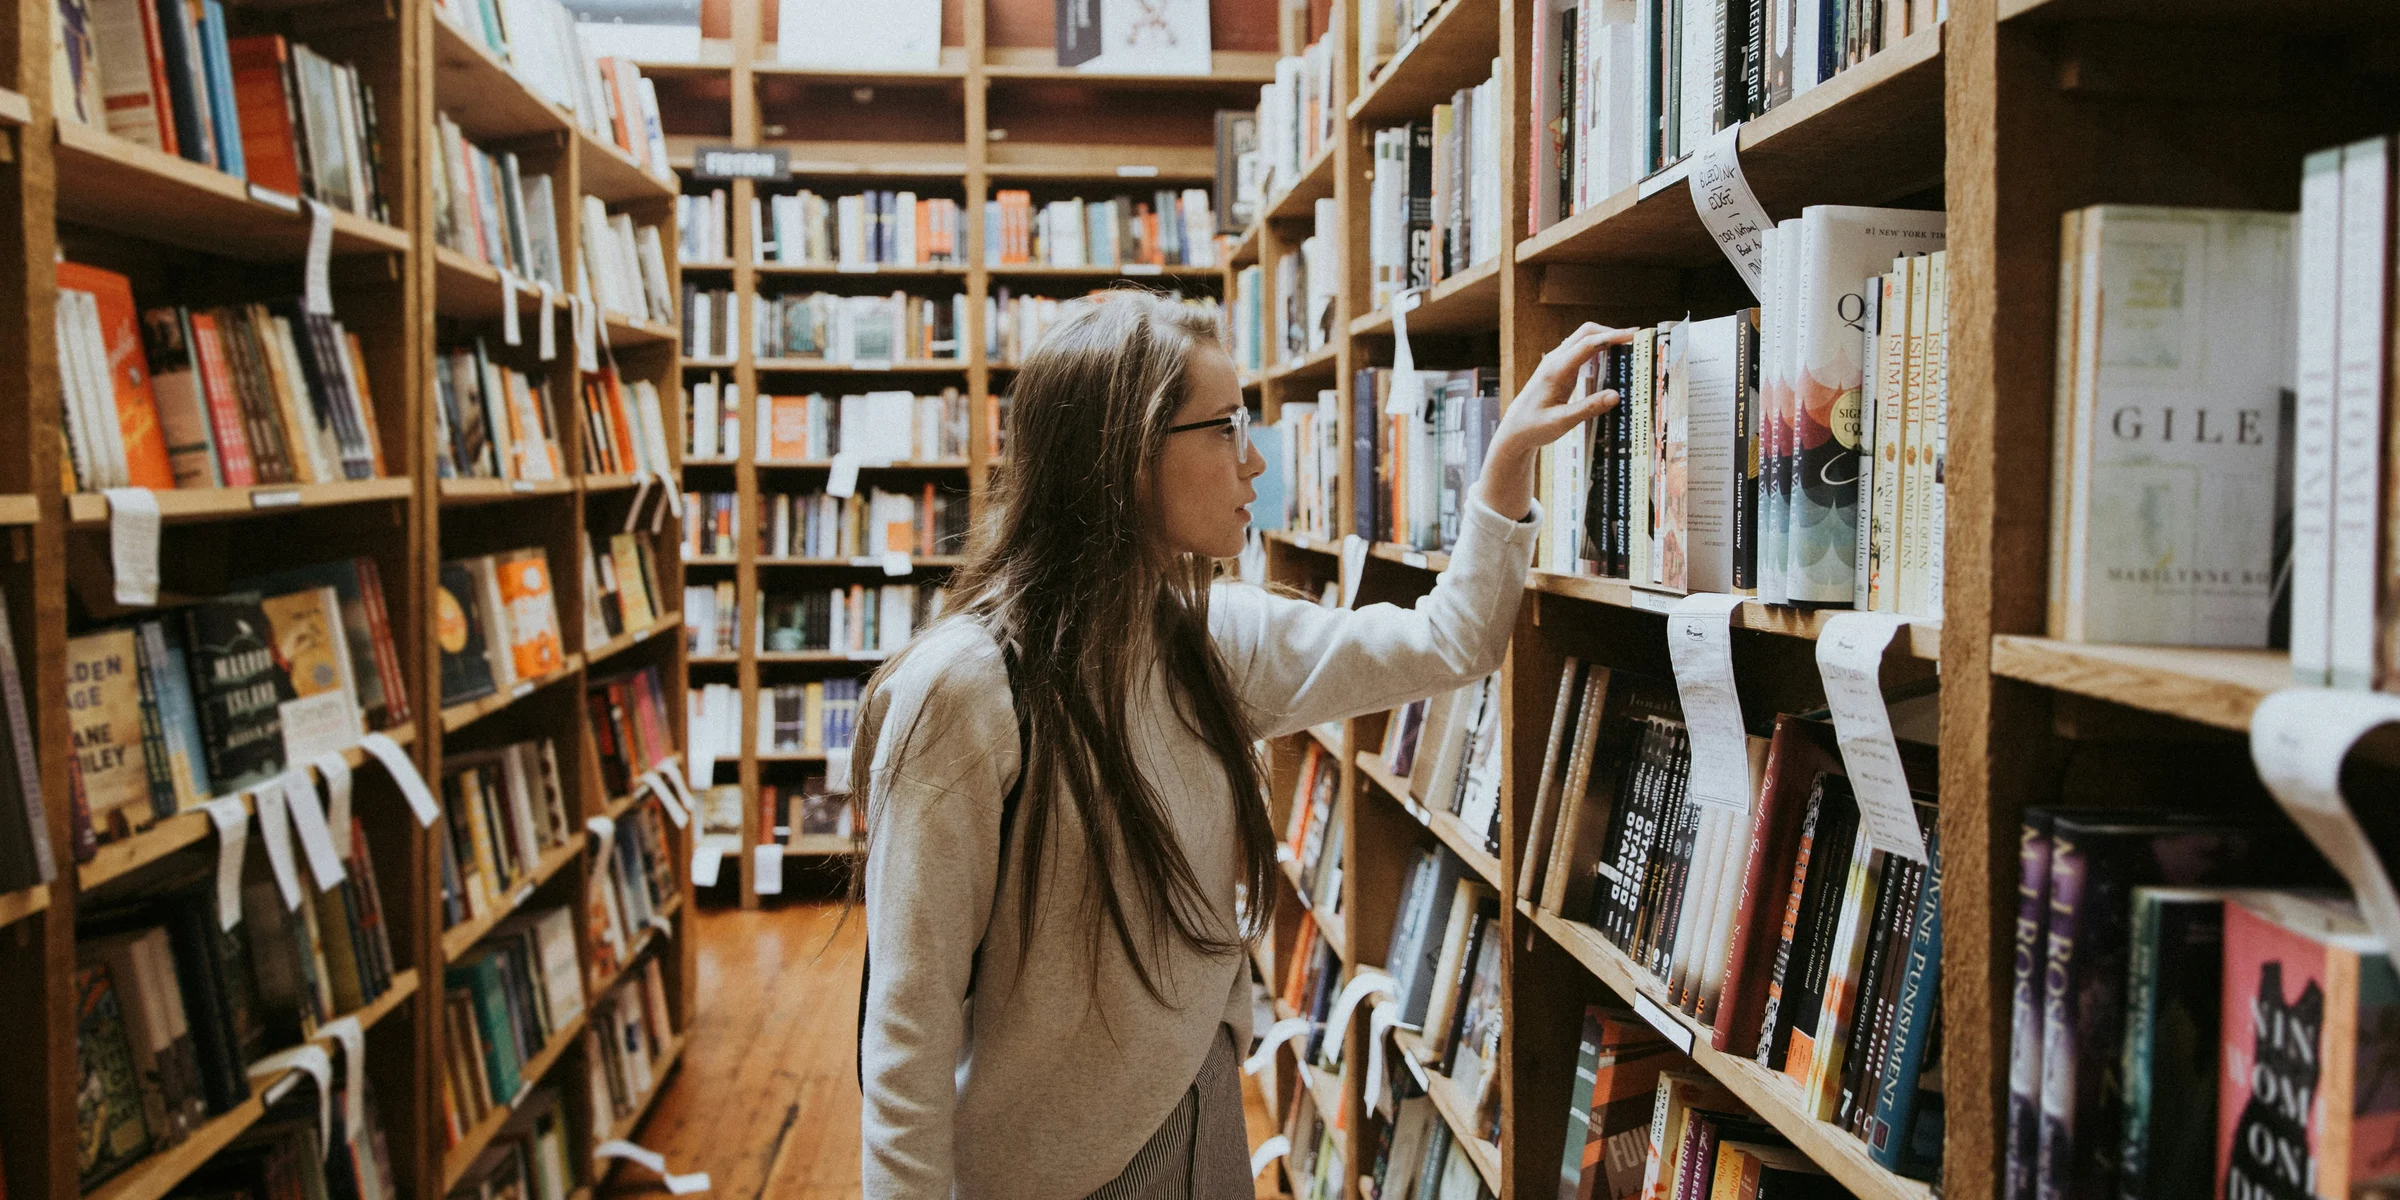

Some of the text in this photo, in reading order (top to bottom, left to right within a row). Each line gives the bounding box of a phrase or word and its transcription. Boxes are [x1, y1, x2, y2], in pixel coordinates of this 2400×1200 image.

[1713, 2, 1726, 113] BLEEDING EDGE
[1748, 0, 1760, 104] LEEDING EDGE
[1709, 188, 1734, 210] EDGE
[1719, 229, 1736, 243] 2013
[1865, 226, 1946, 240] #1 NEW YORK TIM
[1800, 225, 1811, 355] ANNA QUINDLEN
[1618, 388, 1626, 413] MAY
[1737, 321, 1746, 438] Monument Road
[1839, 408, 1861, 419] SIGN
[1886, 333, 1902, 428] ISHMAEL
[1906, 335, 1922, 431] ISHMAEL
[1924, 331, 1940, 429] ISHMAEL
[1770, 408, 1781, 474] MILLER'S
[1792, 397, 1803, 468] MILLER'S
[2112, 405, 2263, 446] GILE
[1617, 460, 1625, 517] MATTHEW
[1857, 472, 1869, 571] Anna Quindlen
[1881, 472, 1895, 564] DANIEL QUINN
[1902, 476, 1915, 569] DANIEL QUINN
[1918, 475, 1931, 570] DANIEL QUINN
[1616, 520, 1624, 556] QUICK
[1735, 510, 1743, 550] Quimby
[1929, 490, 1944, 605] DANIEL QUINN
[73, 723, 111, 749] ANE
[1650, 771, 1668, 846] IMPERFECTIONISTS
[1659, 756, 1682, 849] THE IMPERFECTIONISTS
[1666, 777, 1685, 853] IMPERFECTIONISTS
[1692, 809, 1700, 830] Fall
[1738, 752, 1775, 911] The Devil in Jerusalem
[1611, 811, 1636, 900] OTARED
[1620, 815, 1645, 906] OTARED
[1629, 820, 1654, 912] OTARED
[1900, 866, 1911, 892] WHY
[1911, 871, 1921, 898] WHY
[1659, 861, 1677, 936] Tom Rachman
[1668, 865, 1688, 941] Tom Rachman
[1815, 911, 1824, 932] Story
[1825, 916, 1833, 939] Story
[1879, 877, 1895, 921] RAKHA
[1892, 903, 1903, 933] CAME
[1902, 909, 1914, 938] CAME
[1718, 924, 1741, 1011] NAOMI RAGEN
[1804, 949, 1816, 989] Childhood
[1813, 953, 1826, 995] Childhood
[1853, 950, 1879, 1051] the CROCODILES
[1882, 851, 1942, 1112] DIVINE PUNISHMENT
[2013, 917, 2040, 1015] ROSE
[2043, 932, 2075, 1033] ROSE
[1865, 997, 1884, 1073] MARY RAKOW
[1874, 1003, 1894, 1080] MARY RAKOW
[1718, 1152, 1729, 1184] KNOW
[1729, 1164, 1741, 1199] KNOW
